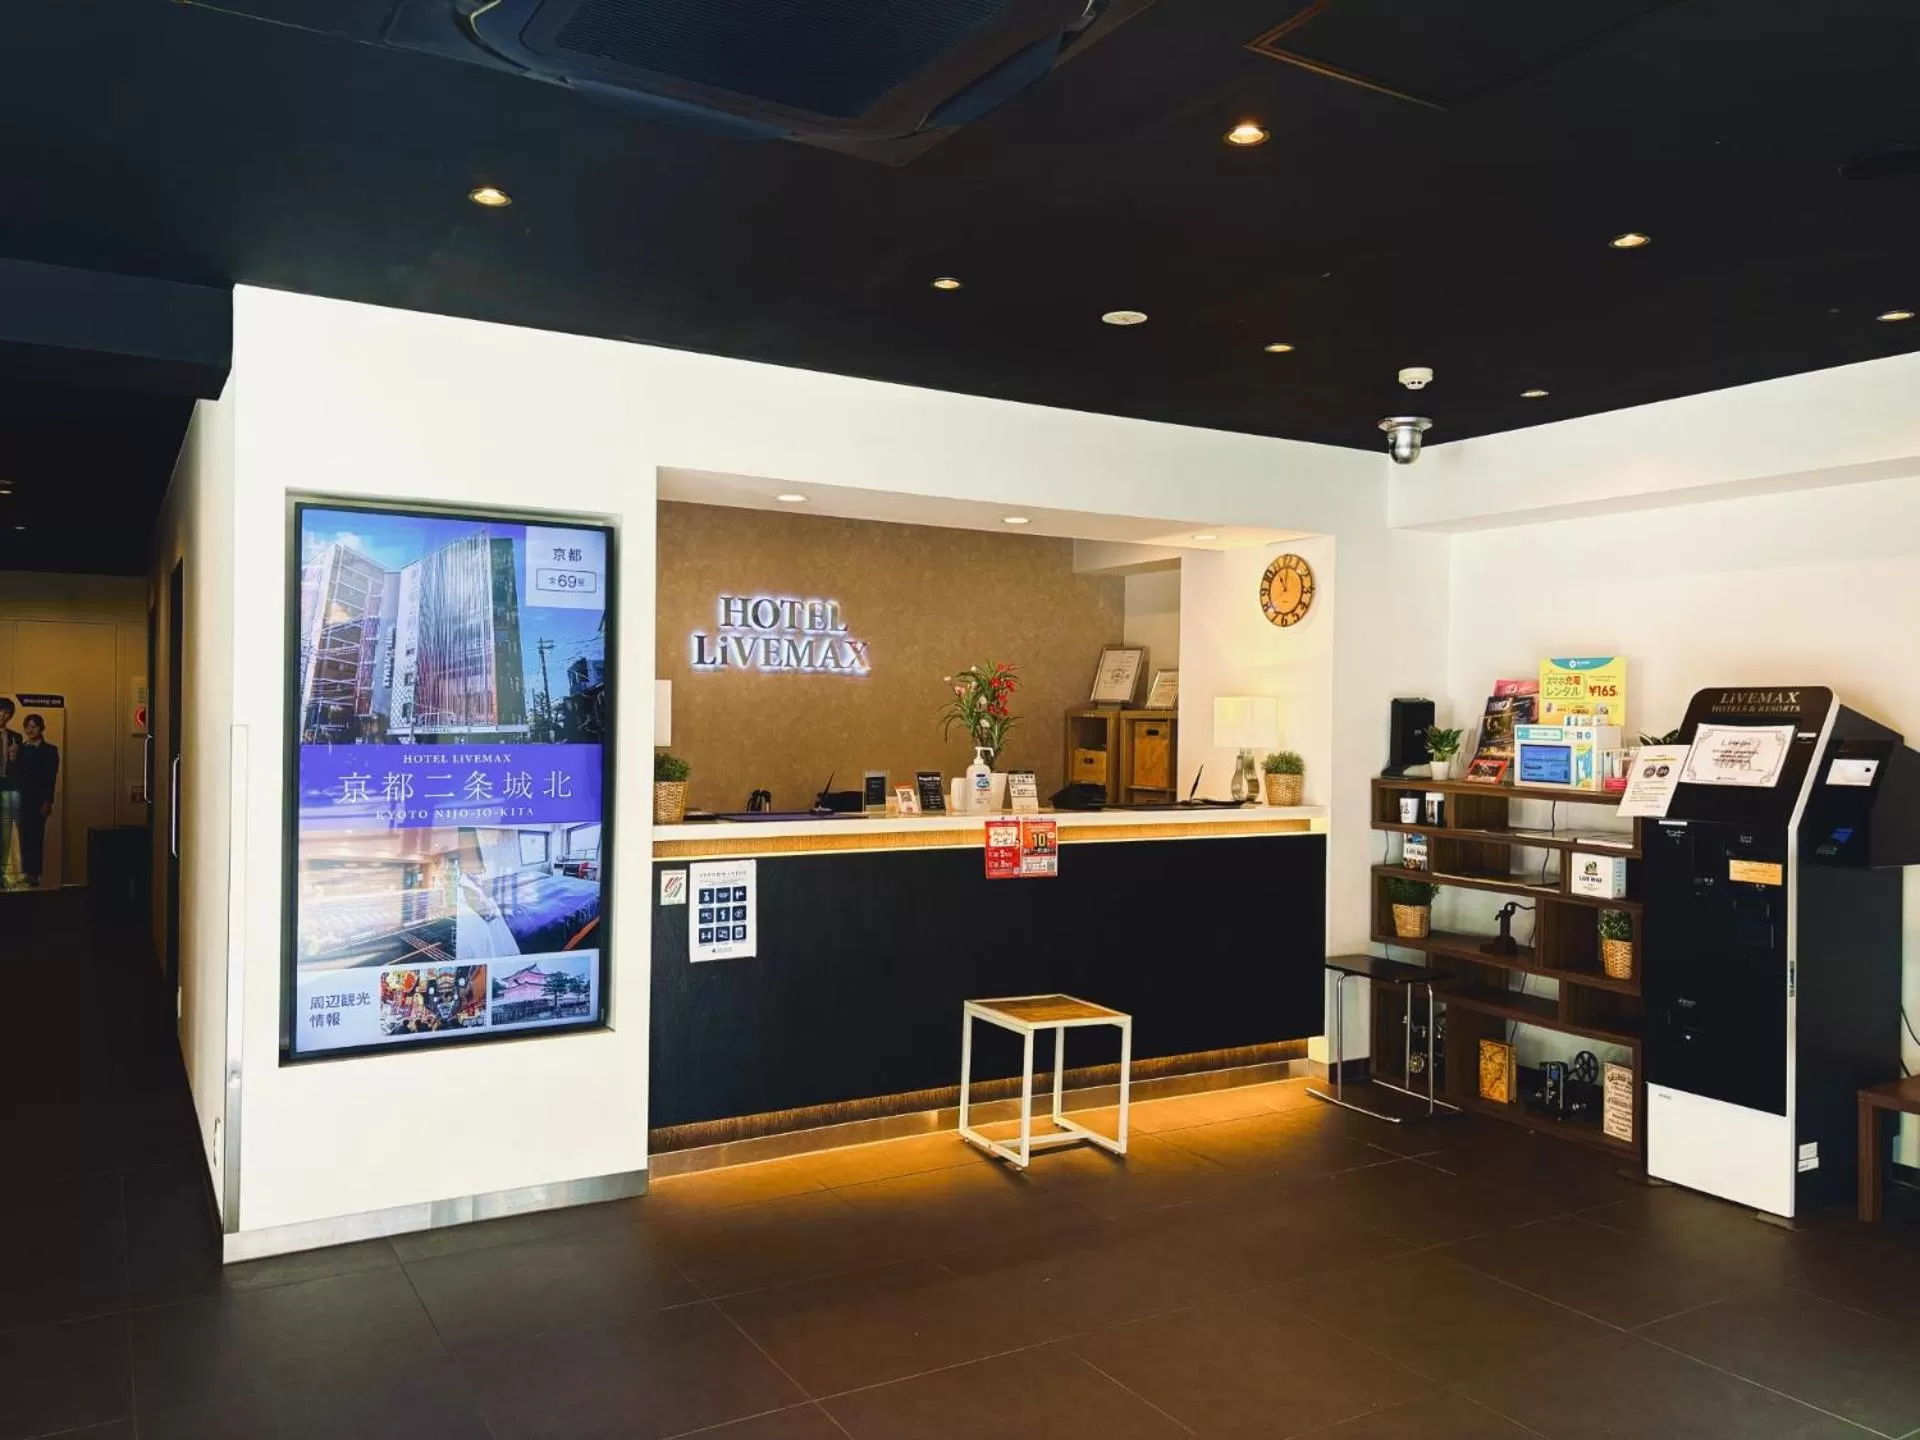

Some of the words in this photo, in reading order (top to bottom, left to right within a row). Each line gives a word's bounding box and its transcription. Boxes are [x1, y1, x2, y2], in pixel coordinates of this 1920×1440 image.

[552, 547, 582, 561] 京都
[720, 596, 849, 632] HOTEL
[693, 634, 871, 671] LiVEMAX
[1546, 675, 1581, 686] スマホ充電
[1546, 686, 1580, 697] レンタル
[1589, 685, 1616, 697] ¥165
[1711, 705, 1747, 713] HOTELS
[1758, 704, 1801, 713] RESORTS
[403, 754, 448, 764] HOTEL
[338, 770, 572, 803] 京都二条城北
[375, 809, 428, 820] KYOTO
[1032, 832, 1046, 848] 10
[310, 991, 371, 1010] 周辺観光
[309, 1011, 340, 1028] 情報
